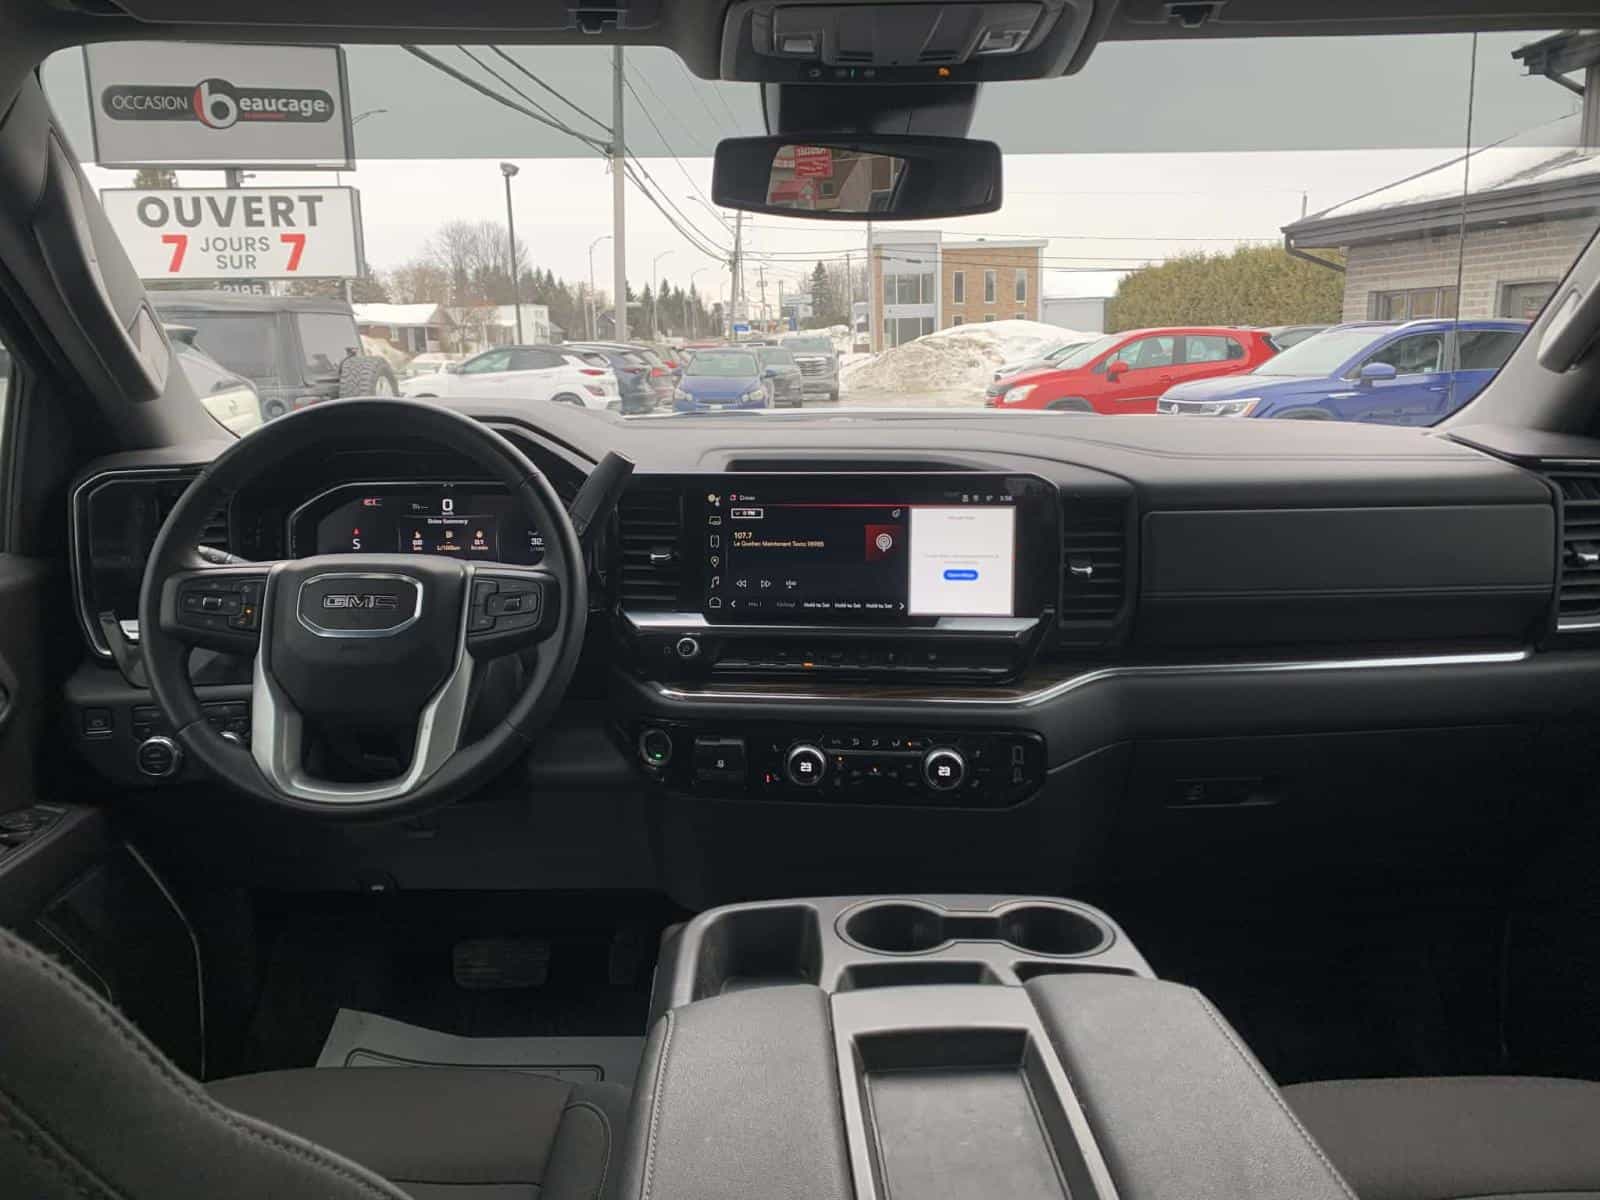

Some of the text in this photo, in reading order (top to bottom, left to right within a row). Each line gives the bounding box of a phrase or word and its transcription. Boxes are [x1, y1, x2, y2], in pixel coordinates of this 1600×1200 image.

[111, 94, 189, 111] OCCASION
[136, 195, 324, 227] OUVERT
[161, 234, 271, 273] 7 JOURS
[216, 233, 306, 272] SUR 7
[442, 498, 453, 511] 0
[733, 531, 752, 540] 107.7
[323, 593, 400, 609] GMC
